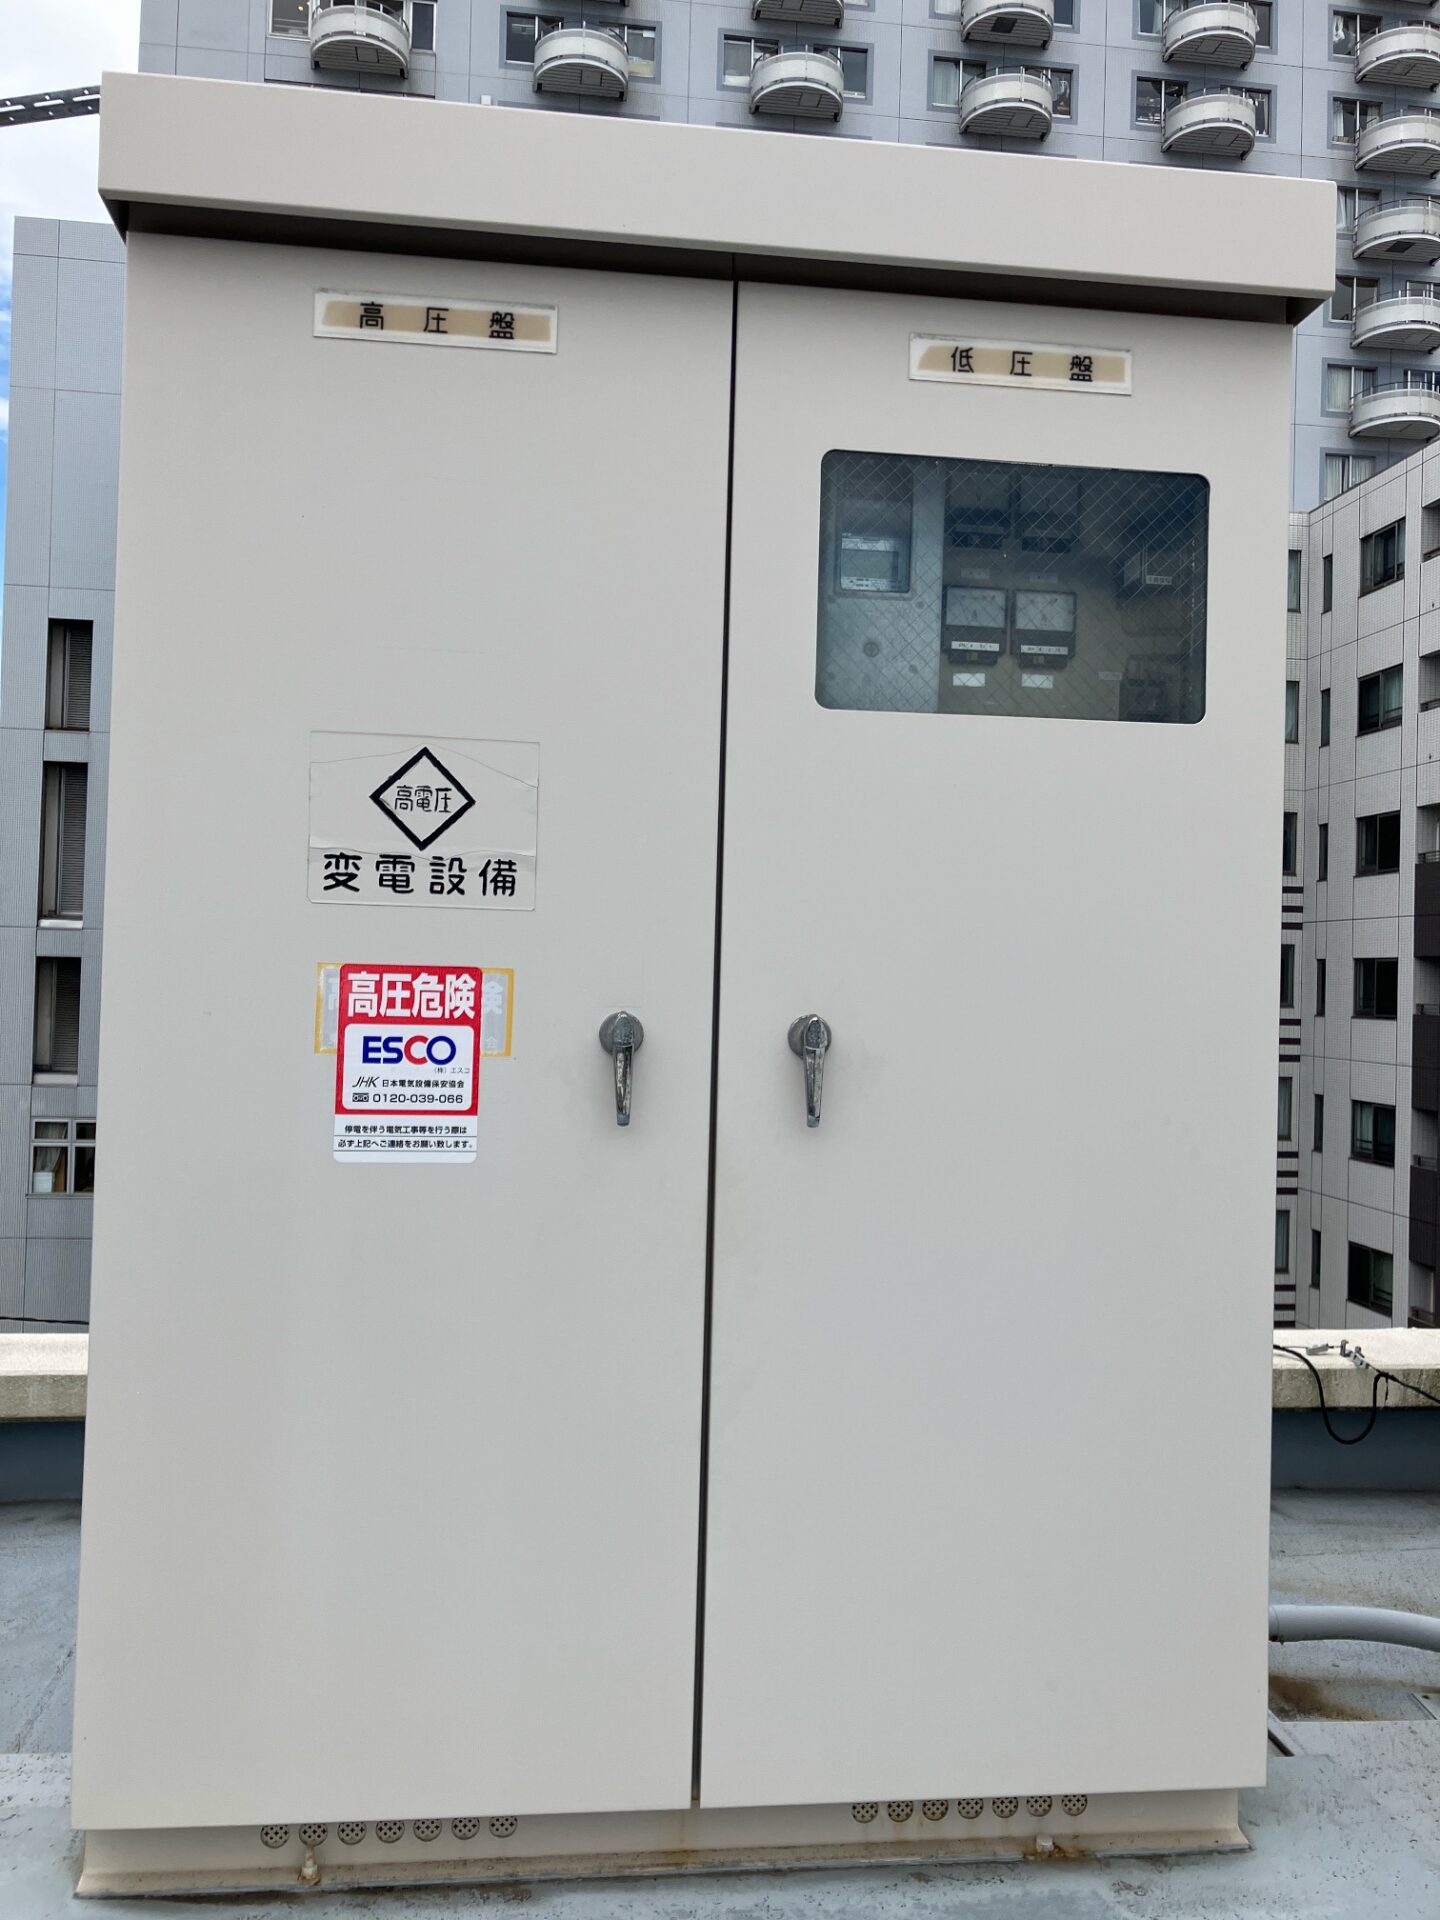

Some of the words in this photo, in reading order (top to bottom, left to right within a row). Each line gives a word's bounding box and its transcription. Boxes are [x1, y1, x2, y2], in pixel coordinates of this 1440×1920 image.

[359, 301, 515, 340] 高圧盤
[951, 346, 1094, 382] 低圧盤
[394, 784, 453, 813] 高電圧
[323, 852, 518, 897] 変電設備
[347, 971, 477, 1019] 高圧危険
[362, 1035, 457, 1065] ESCO
[351, 1076, 380, 1088] JHK
[382, 1079, 465, 1089] 日本電気設備保安協会
[372, 1093, 464, 1104] 0120-039-066
